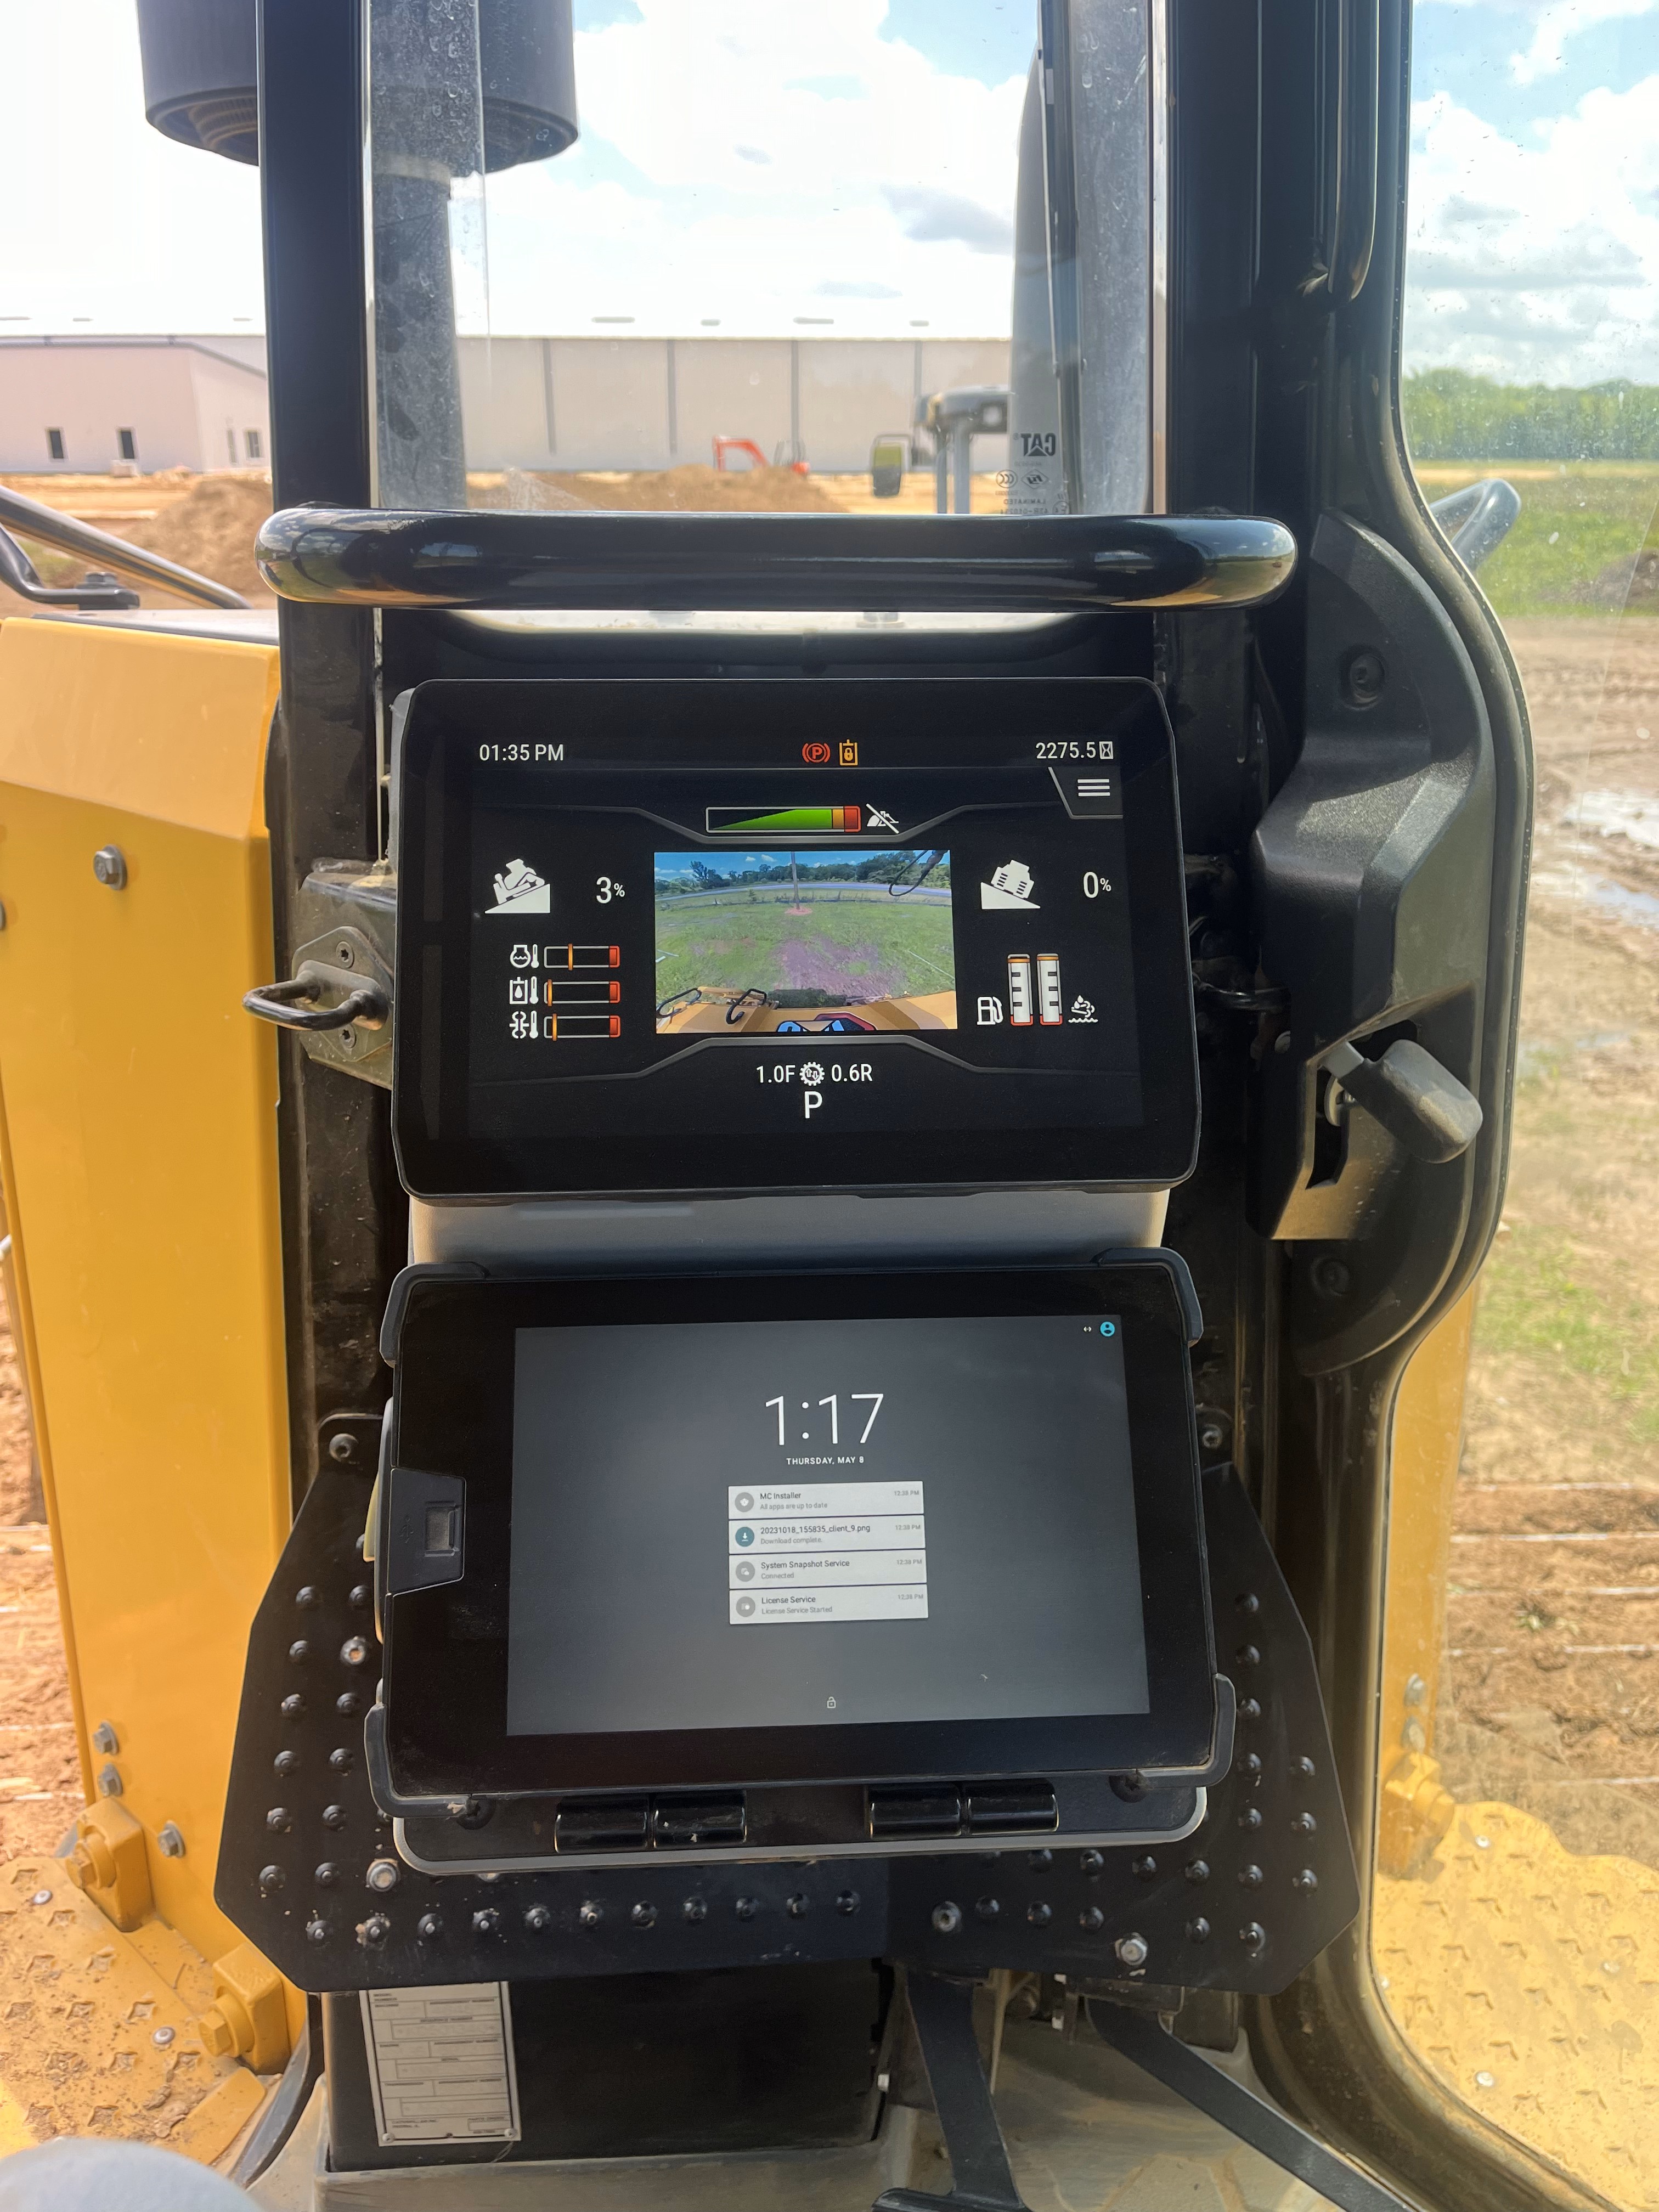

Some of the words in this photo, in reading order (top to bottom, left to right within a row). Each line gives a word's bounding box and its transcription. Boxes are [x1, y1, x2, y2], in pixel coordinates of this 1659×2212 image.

[479, 744, 530, 761] 01:35
[535, 744, 563, 761] PM
[1035, 742, 1096, 759] 2275.5
[596, 876, 625, 904] 3%
[1083, 871, 1111, 898] 0%
[756, 1065, 796, 1083] 1.0F
[831, 1063, 873, 1082] 0.6R
[804, 1091, 823, 1119] P
[765, 1393, 884, 1446] 1:17
[786, 1457, 834, 1465] THURSDAY,
[761, 1562, 787, 1570] System
[789, 1560, 823, 1568] Snapshot
